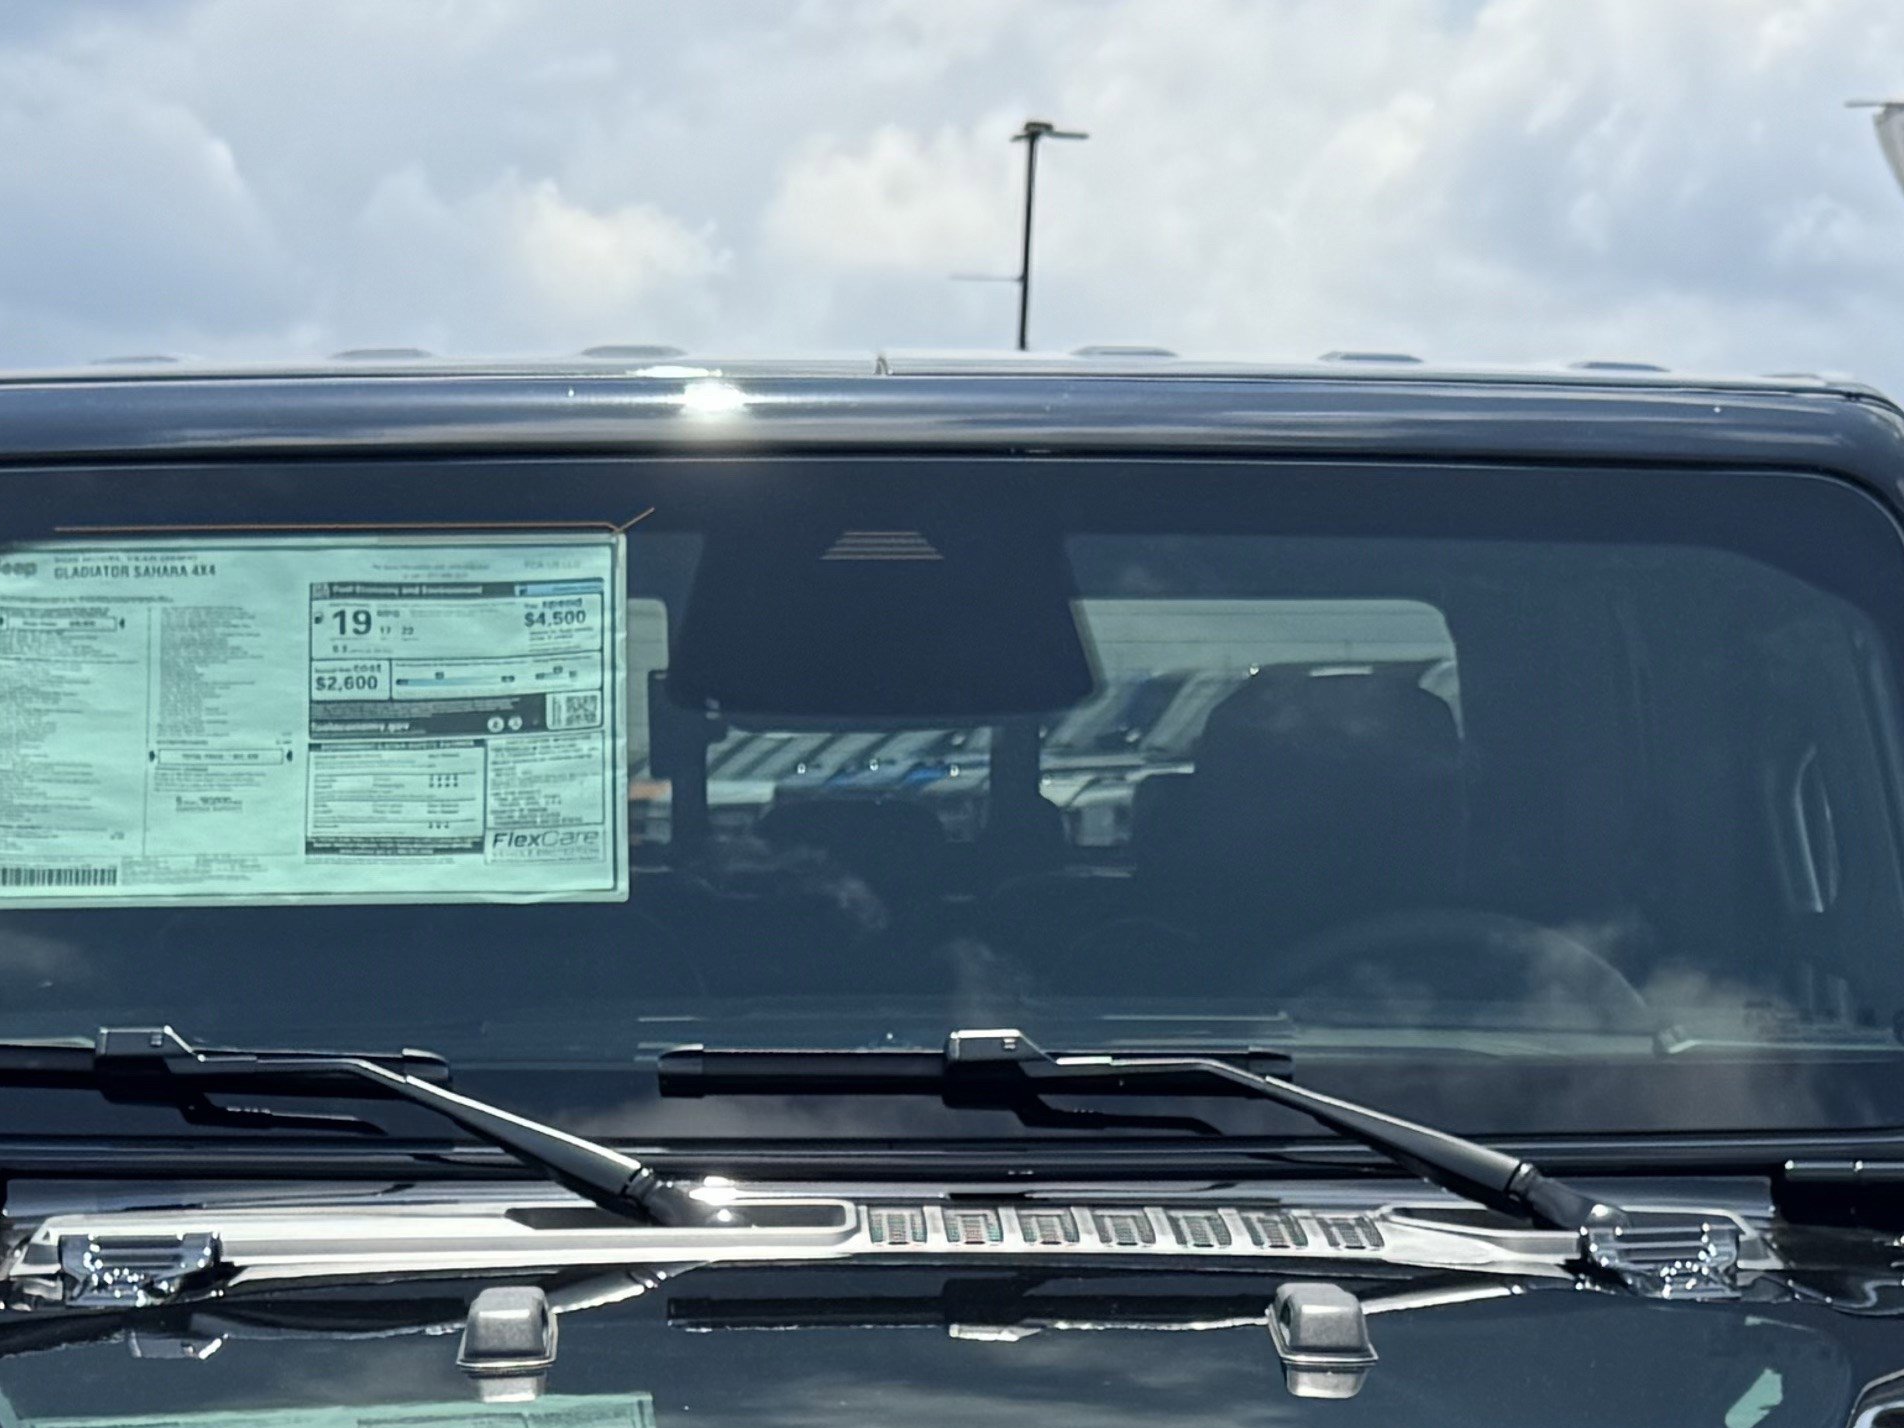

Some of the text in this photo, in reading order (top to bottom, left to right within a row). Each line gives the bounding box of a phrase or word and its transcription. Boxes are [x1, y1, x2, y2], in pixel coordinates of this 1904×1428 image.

[54, 565, 130, 579] GLADIATOR
[133, 565, 189, 578] SAHARA
[332, 609, 372, 636] 19
[524, 609, 587, 627] $4,500
[315, 675, 379, 692] $2,600
[492, 831, 599, 849] FlexCare
